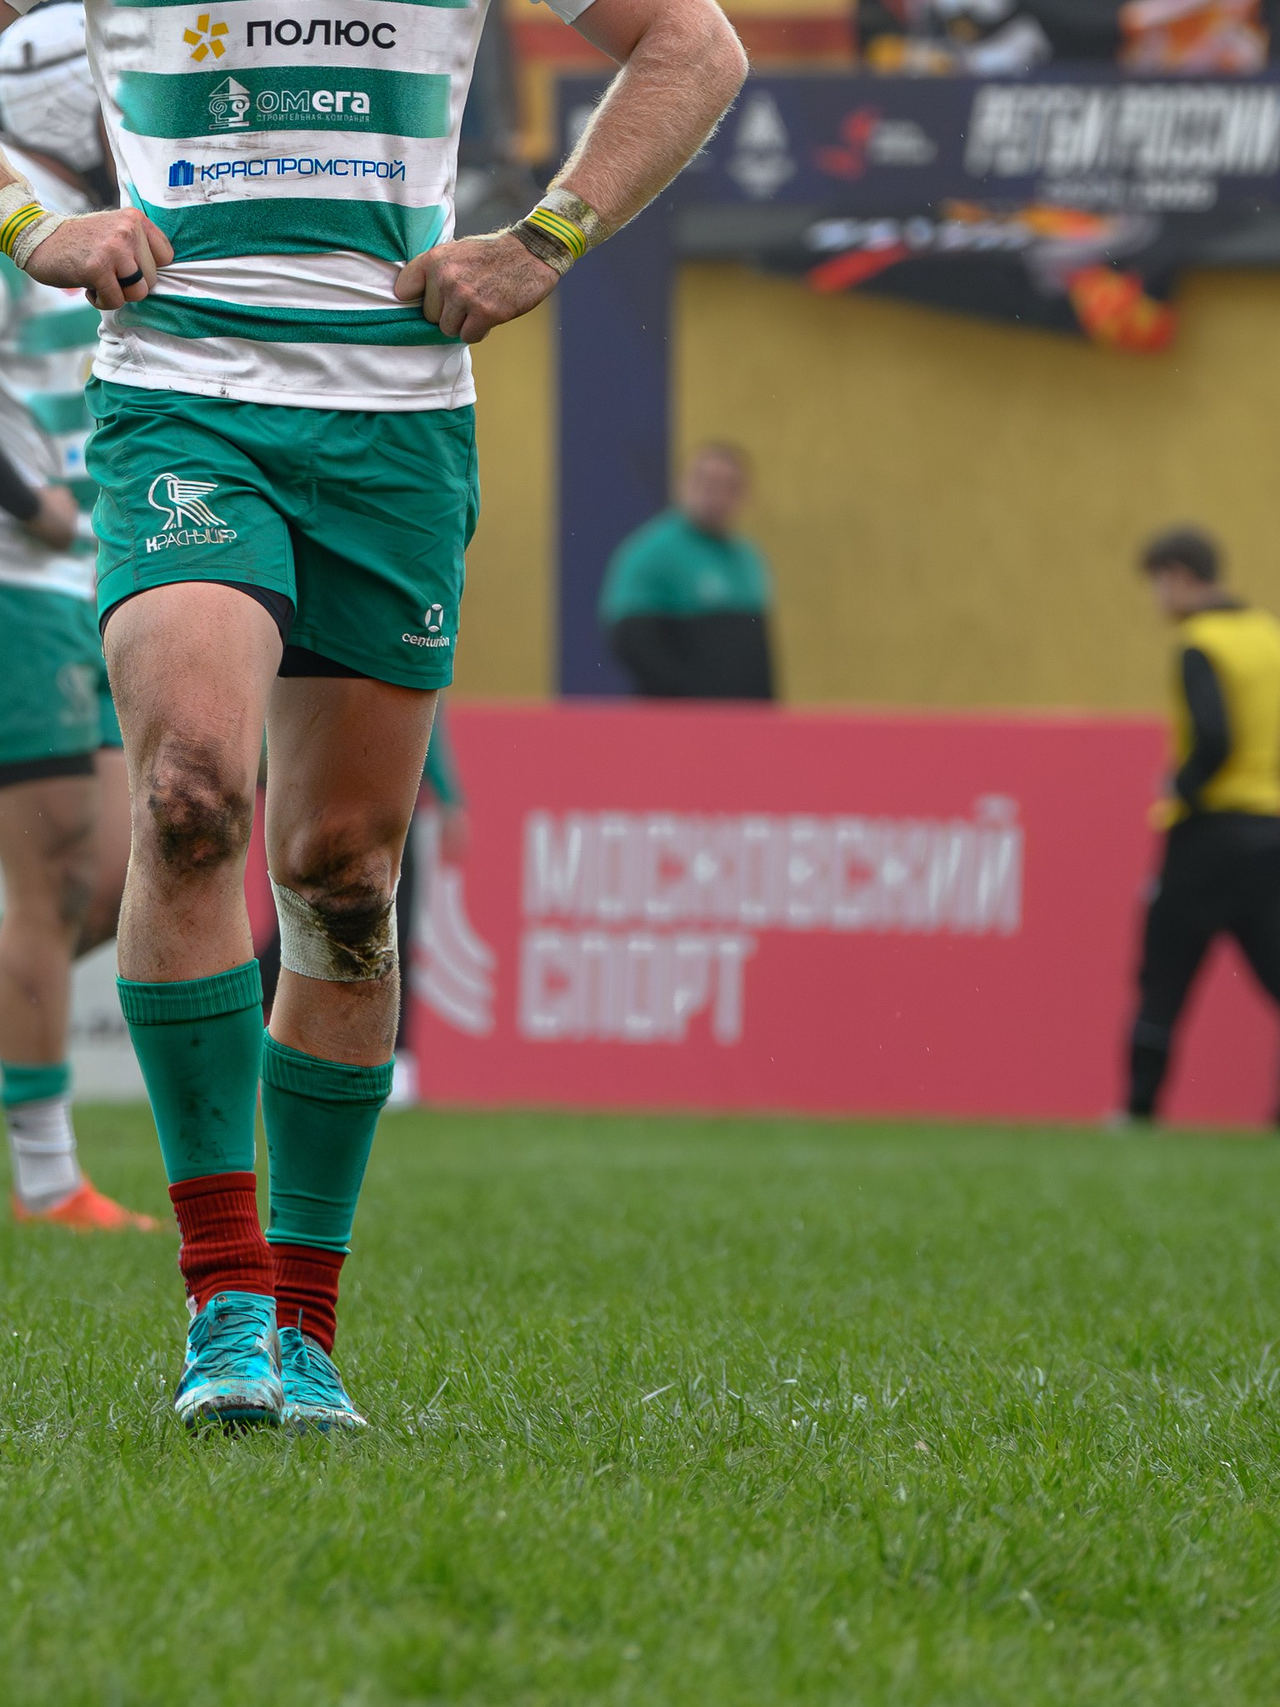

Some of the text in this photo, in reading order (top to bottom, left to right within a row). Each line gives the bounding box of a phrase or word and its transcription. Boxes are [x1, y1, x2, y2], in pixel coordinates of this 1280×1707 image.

[246, 19, 397, 49] ПОЛЮС
[257, 113, 370, 123] СТРОИТЕЛЬНАЯ КОМПАНИЯ
[200, 158, 406, 182] КРАСПРОМСТРОЙ
